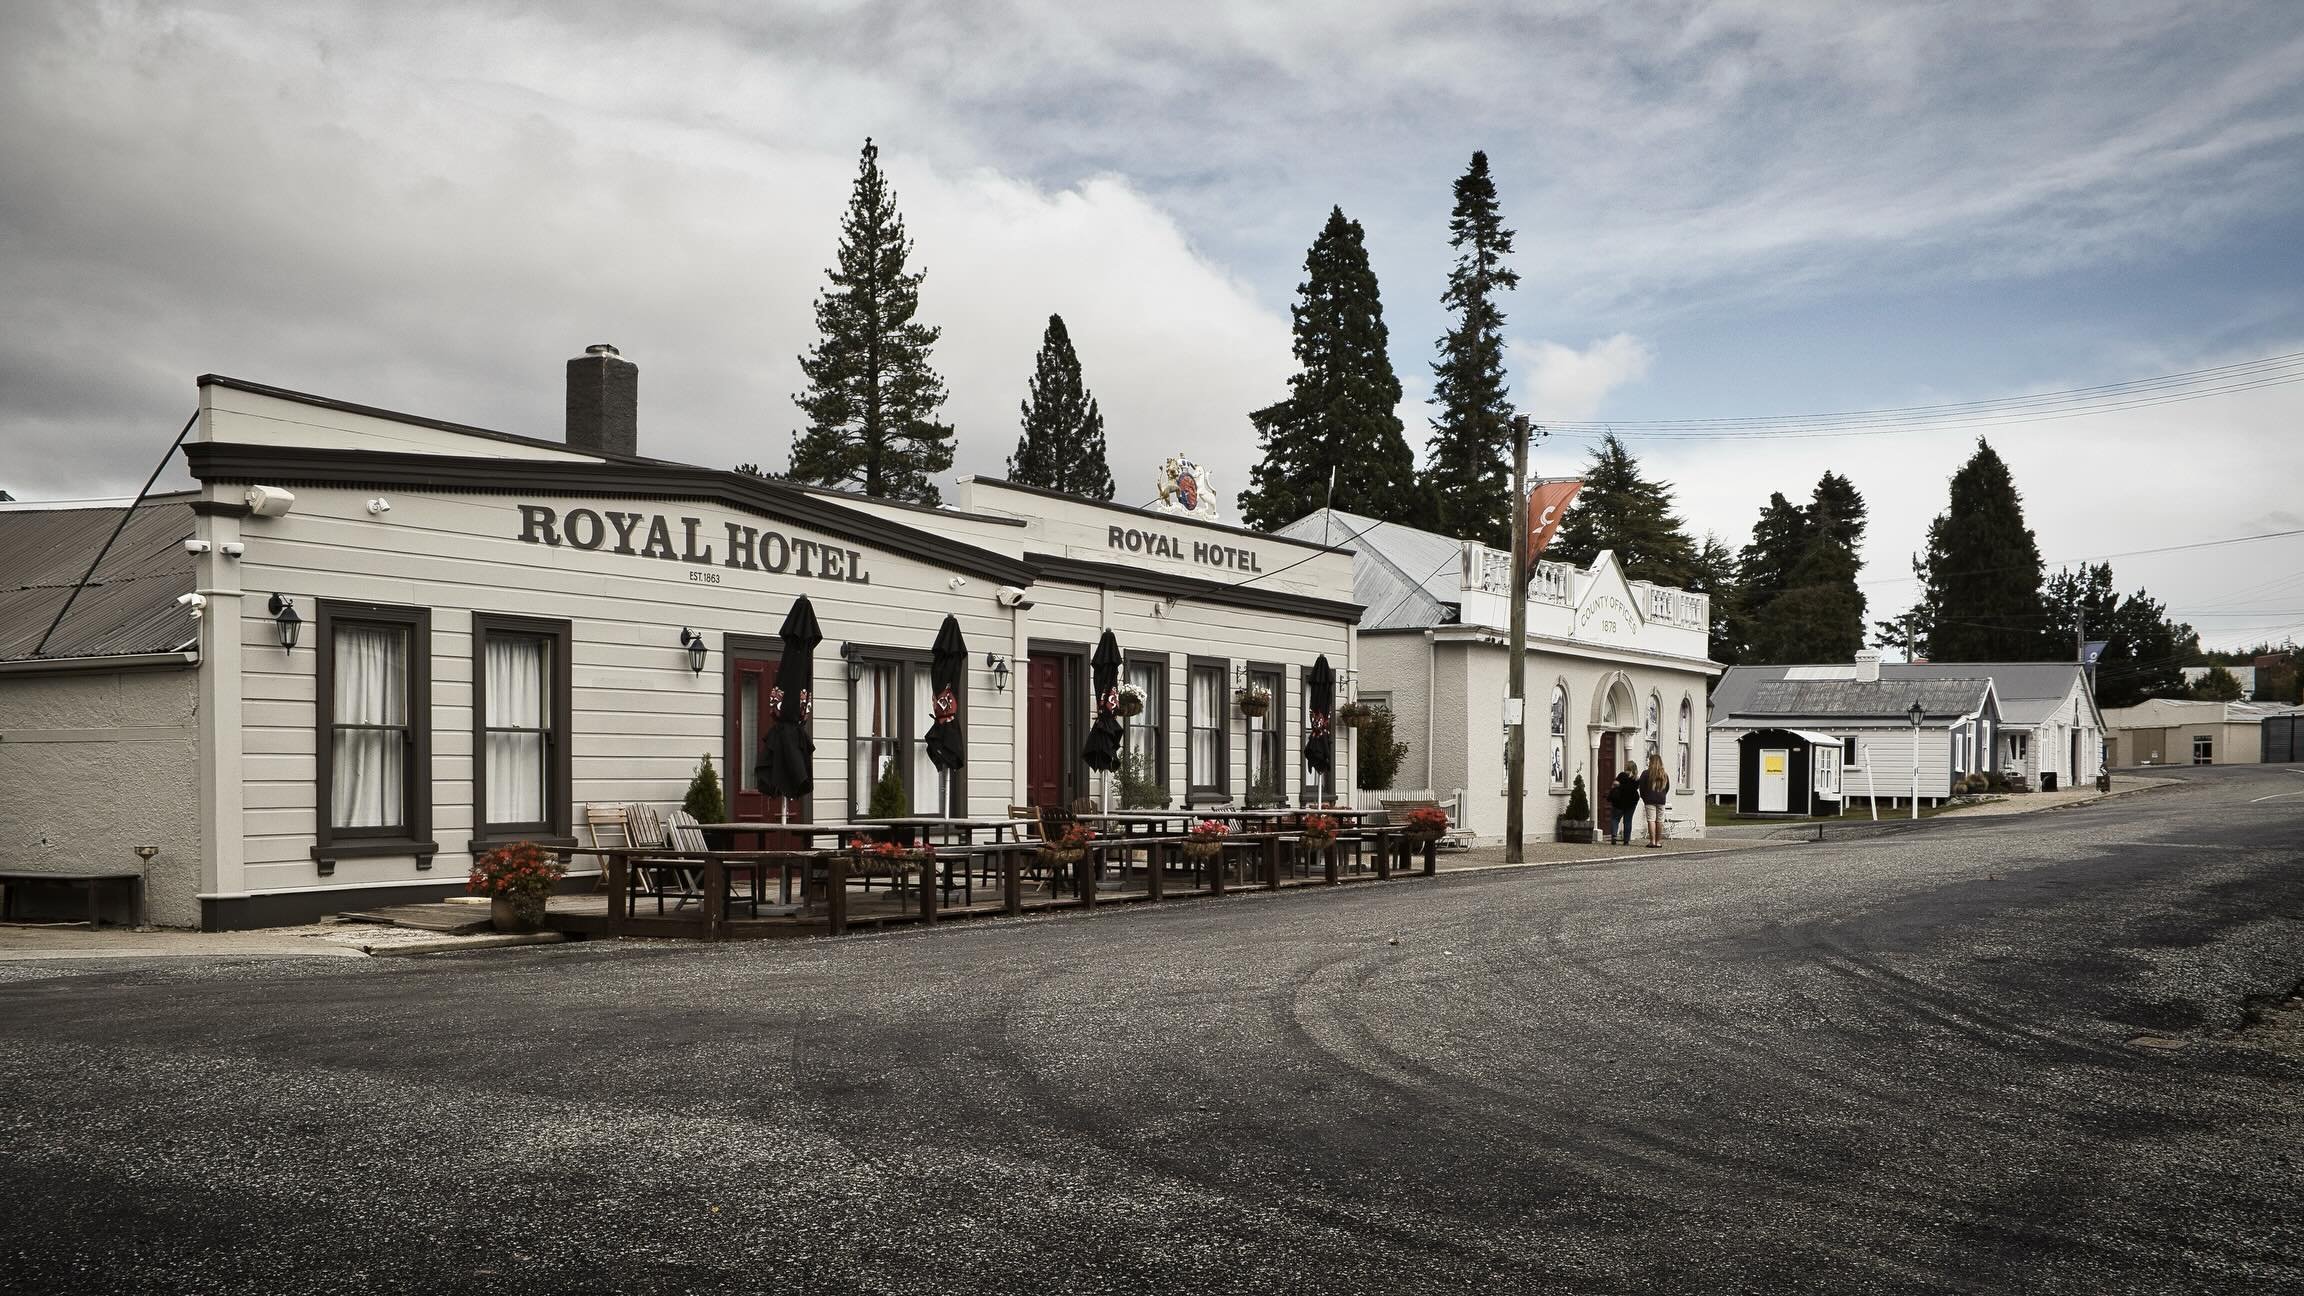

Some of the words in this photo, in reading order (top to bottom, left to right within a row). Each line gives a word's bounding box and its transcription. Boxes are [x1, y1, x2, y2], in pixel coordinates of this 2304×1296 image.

[517, 504, 713, 565] ROYAL
[724, 521, 870, 585] HOTEL
[1108, 525, 1185, 560] ROYAL
[1193, 541, 1262, 574] HOTEL
[1581, 595, 1609, 627] COUNTY
[1609, 596, 1637, 635] OFFICES
[1602, 619, 1617, 633] 1878
